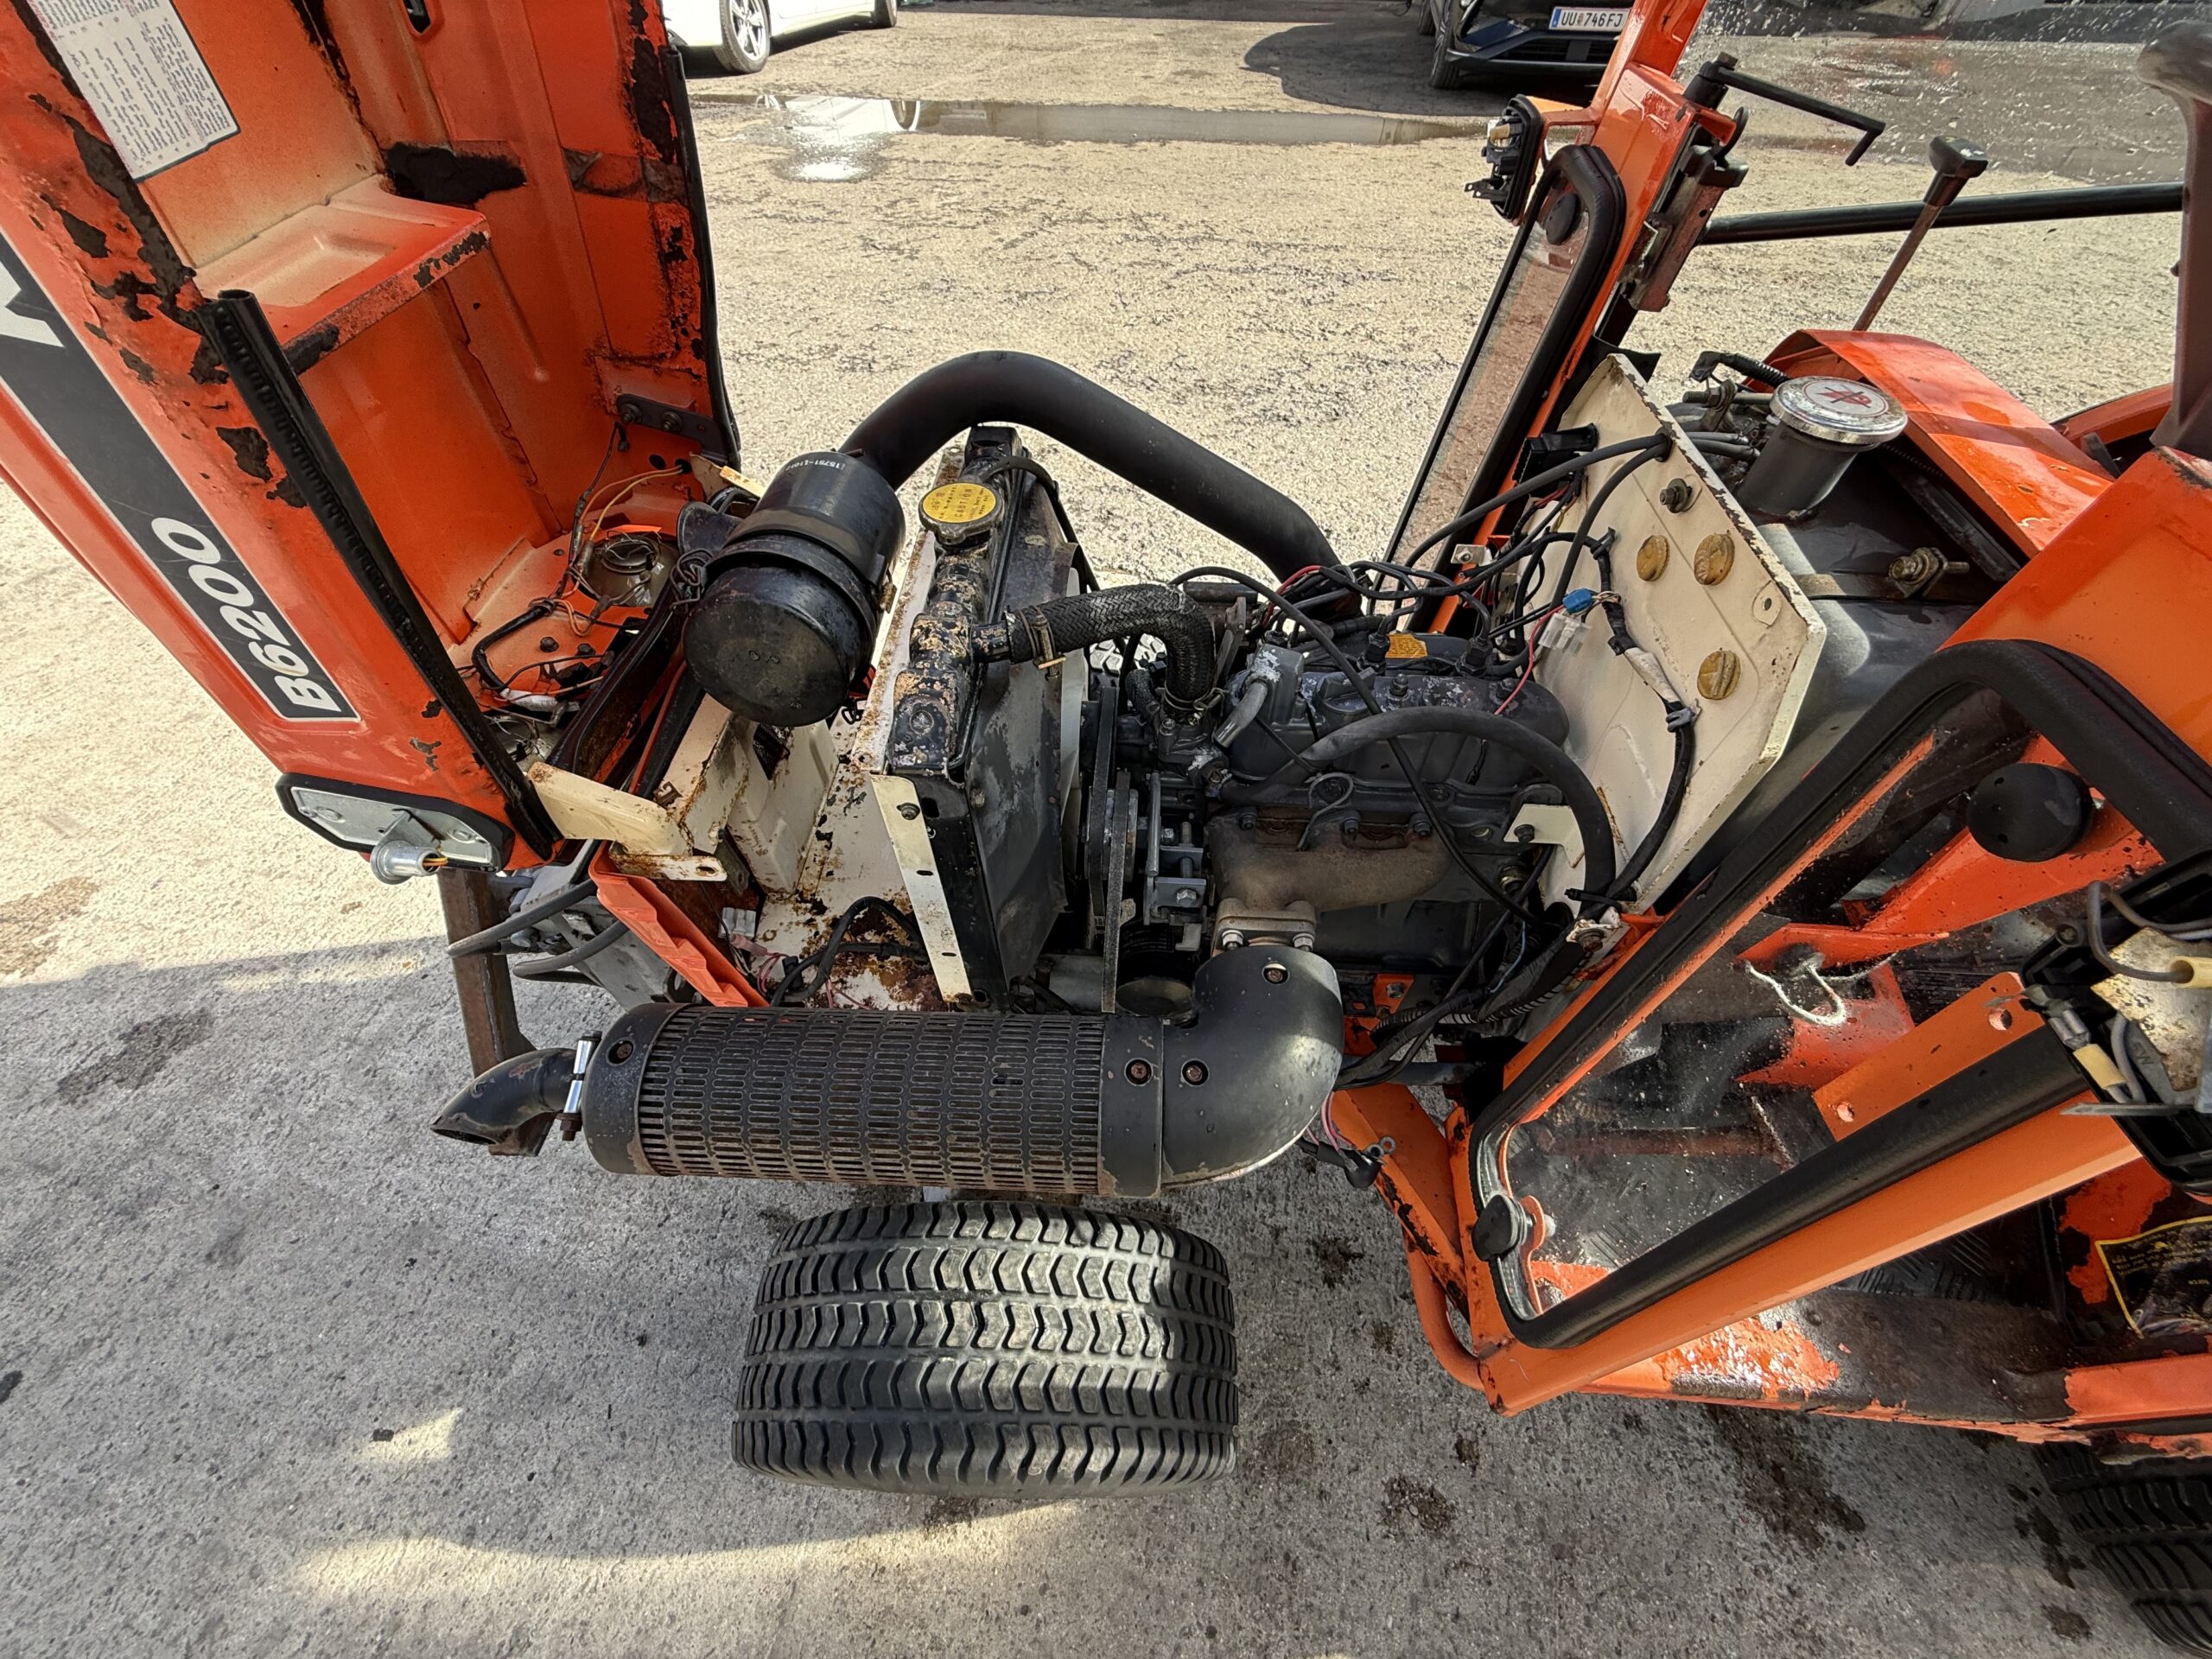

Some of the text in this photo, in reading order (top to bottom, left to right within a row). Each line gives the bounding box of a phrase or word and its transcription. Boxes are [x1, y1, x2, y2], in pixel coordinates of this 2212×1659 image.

[1561, 11, 1578, 27] UU
[954, 488, 973, 518] CAUTION
[151, 518, 341, 712] B6200
